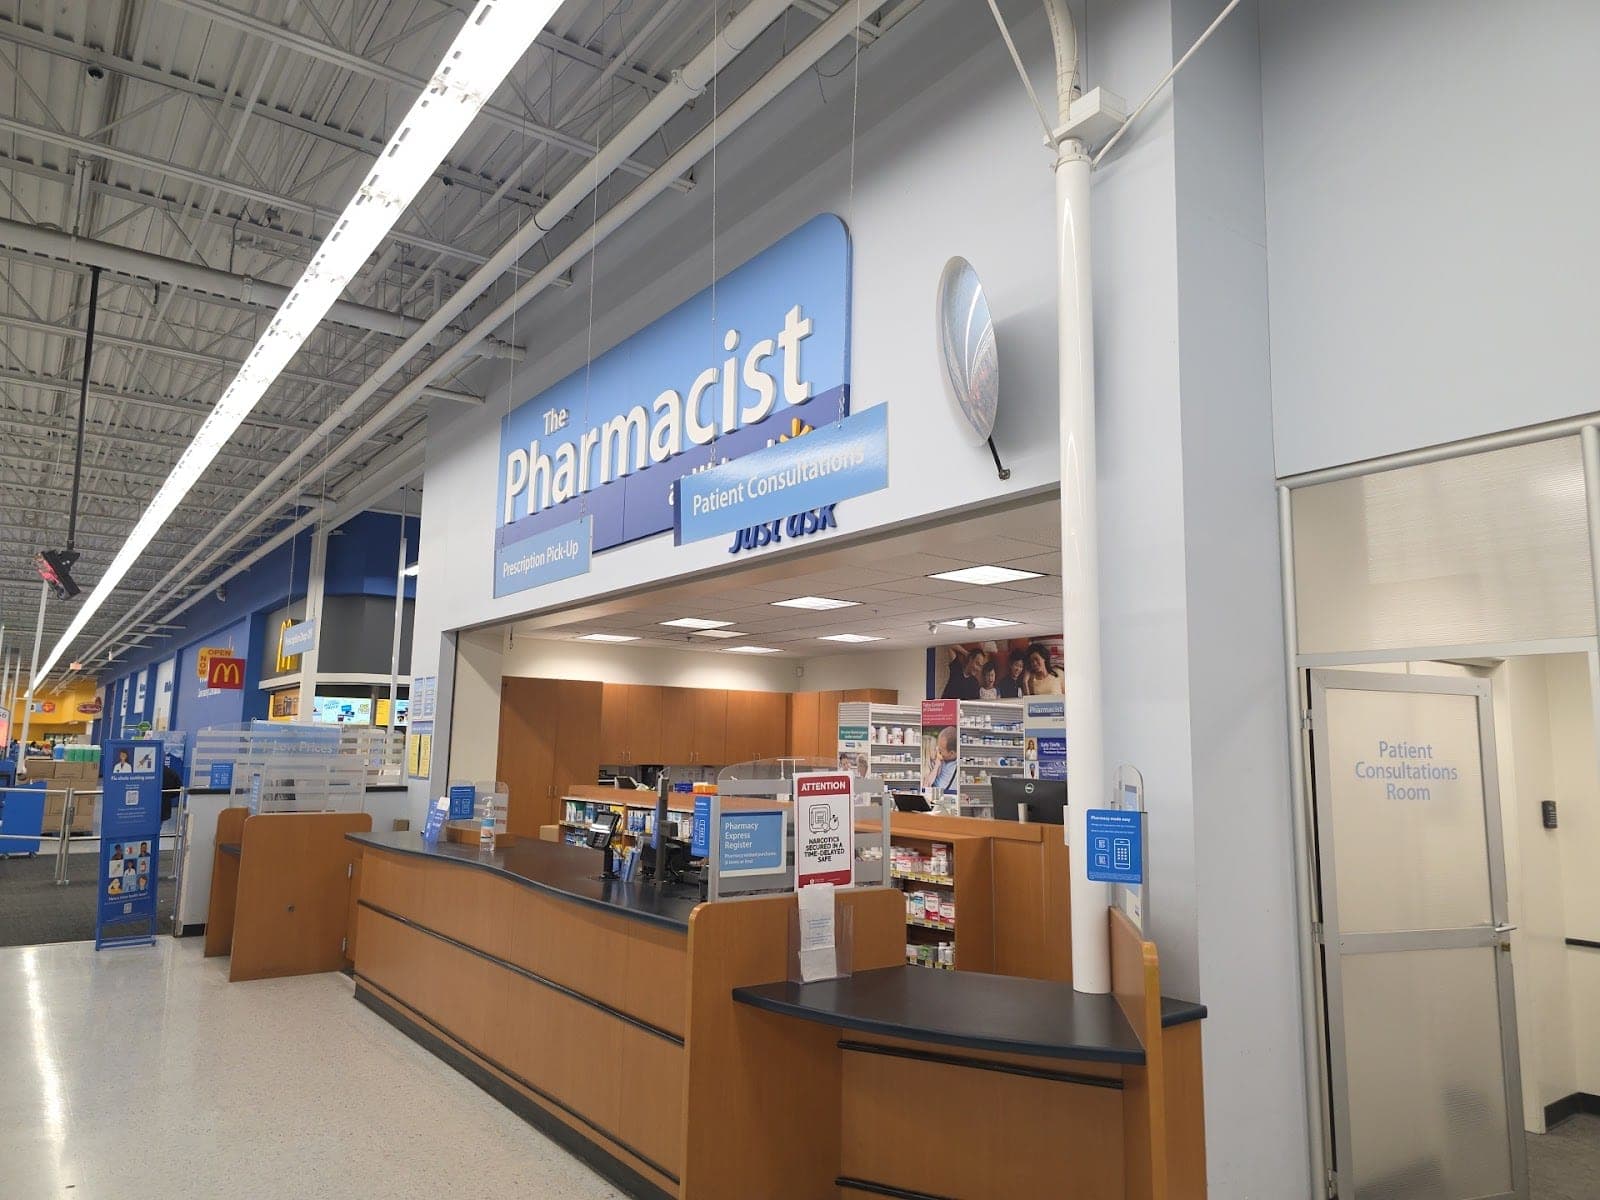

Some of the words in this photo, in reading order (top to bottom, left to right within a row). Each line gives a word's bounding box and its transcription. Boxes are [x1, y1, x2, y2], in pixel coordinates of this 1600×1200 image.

[504, 303, 814, 525] Pharmacist
[543, 407, 569, 436] The
[692, 482, 744, 517] Patient
[746, 449, 865, 499] Consultations
[503, 551, 545, 578] Prescription
[546, 539, 579, 564] Pick-Up
[207, 648, 232, 657] OPEN
[1379, 740, 1433, 759] Patient
[1355, 761, 1458, 780] Consultations
[801, 781, 846, 792] ATTENTION
[1386, 783, 1431, 801] Room
[724, 822, 759, 831] Pharmacy
[724, 831, 751, 841] Express
[808, 836, 840, 845] NARCOTICS
[724, 841, 753, 851] Register
[805, 843, 831, 851] SECURED
[804, 848, 845, 858] TIME-DELAYED
